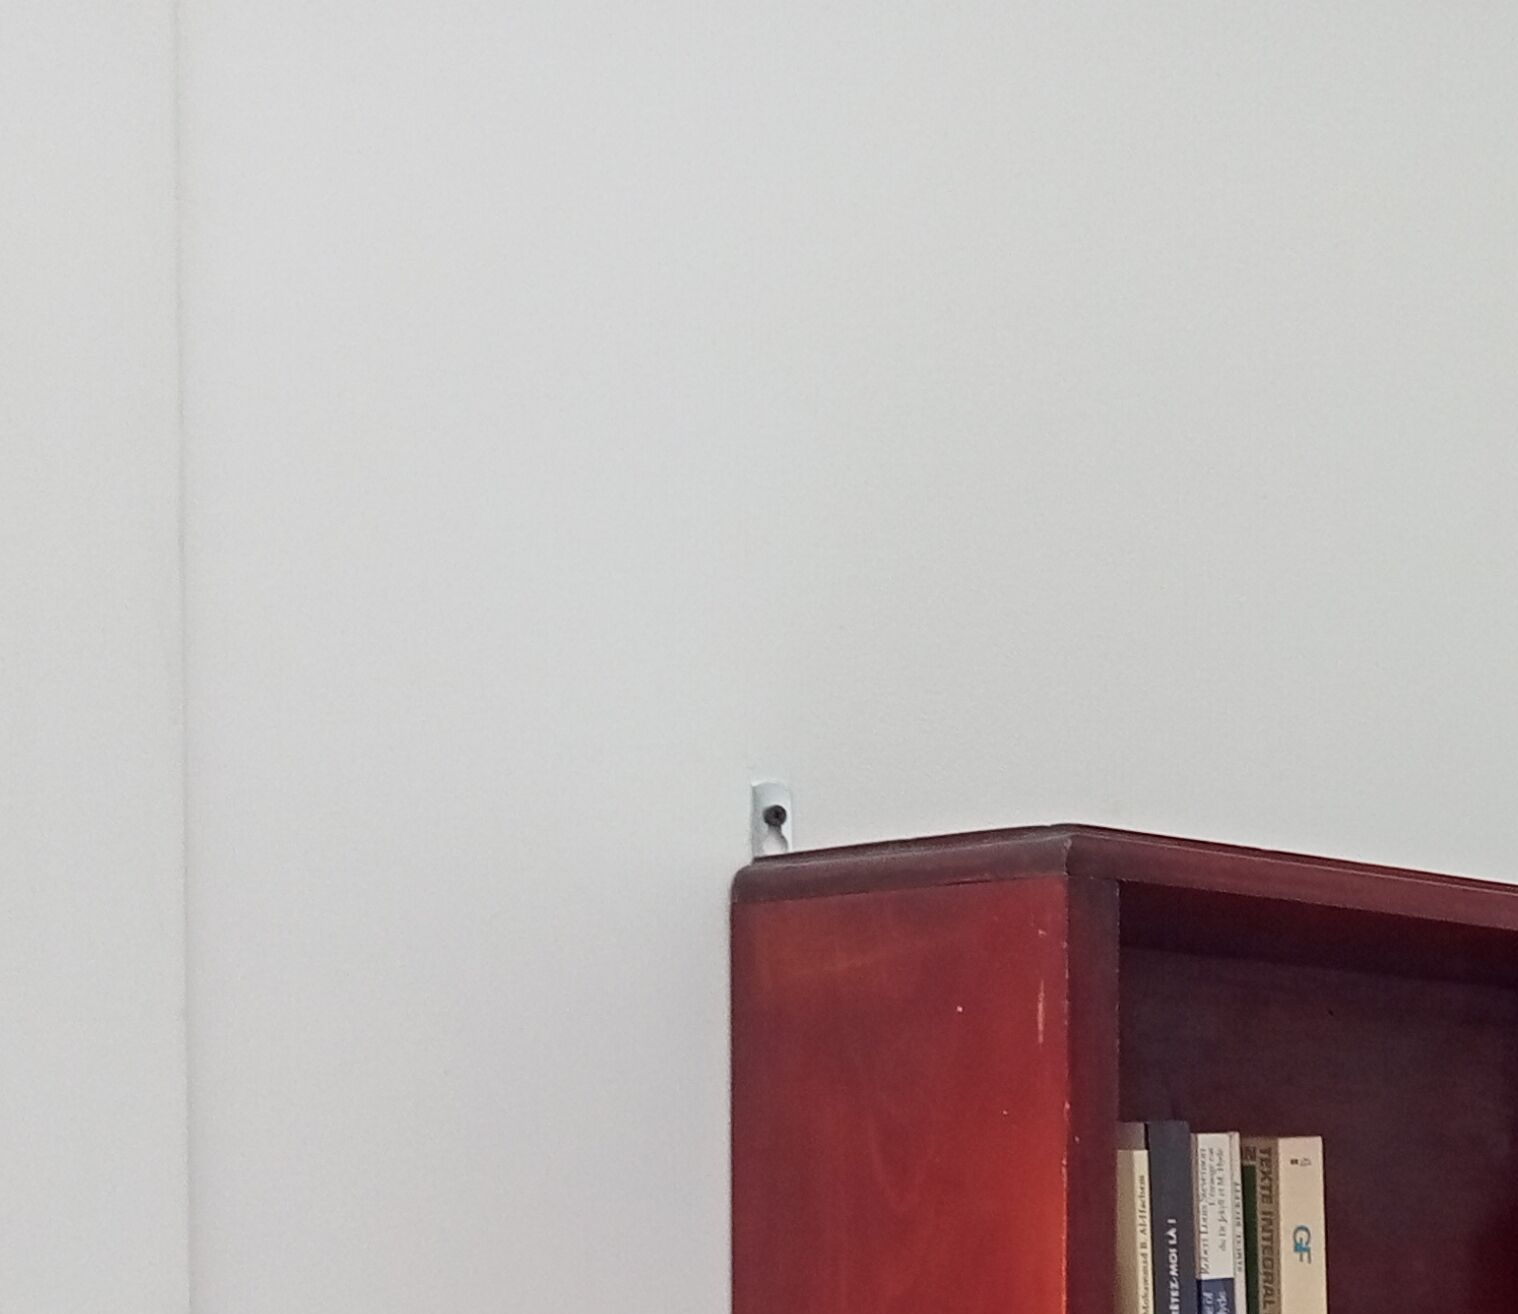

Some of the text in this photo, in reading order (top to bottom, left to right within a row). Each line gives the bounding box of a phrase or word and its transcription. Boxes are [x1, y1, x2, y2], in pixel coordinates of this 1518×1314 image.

[1258, 1147, 1273, 1205] TEXTE
[1260, 1210, 1276, 1309] INTEGRAL
[1293, 1225, 1312, 1264] GF
